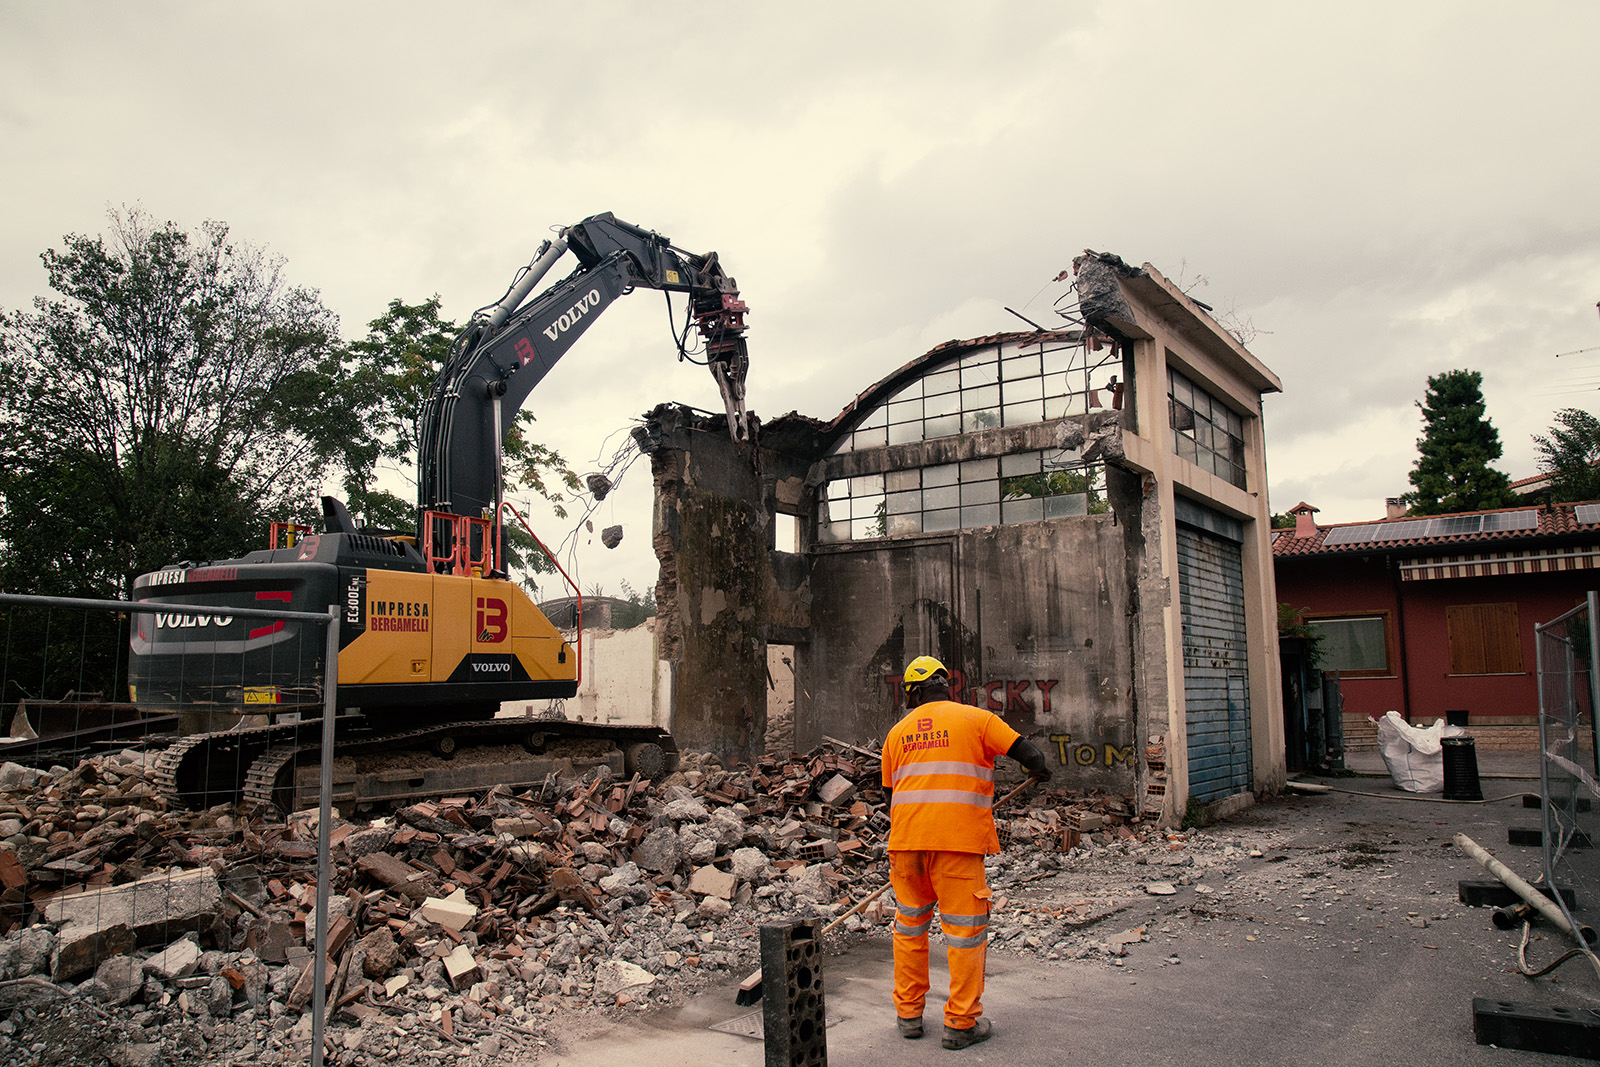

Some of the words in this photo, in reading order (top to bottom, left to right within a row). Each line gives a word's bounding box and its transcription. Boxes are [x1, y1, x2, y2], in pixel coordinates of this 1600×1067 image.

[542, 288, 601, 342] VOLVO
[148, 570, 186, 587] IMPRESA
[186, 567, 239, 583] BERGAMELLI
[371, 600, 429, 617] IMPRESA
[371, 617, 429, 632] BERGAMELLI
[472, 663, 511, 672] VOLVO
[901, 729, 949, 745] IMPRESA
[902, 738, 950, 754] BERGAMELLI
